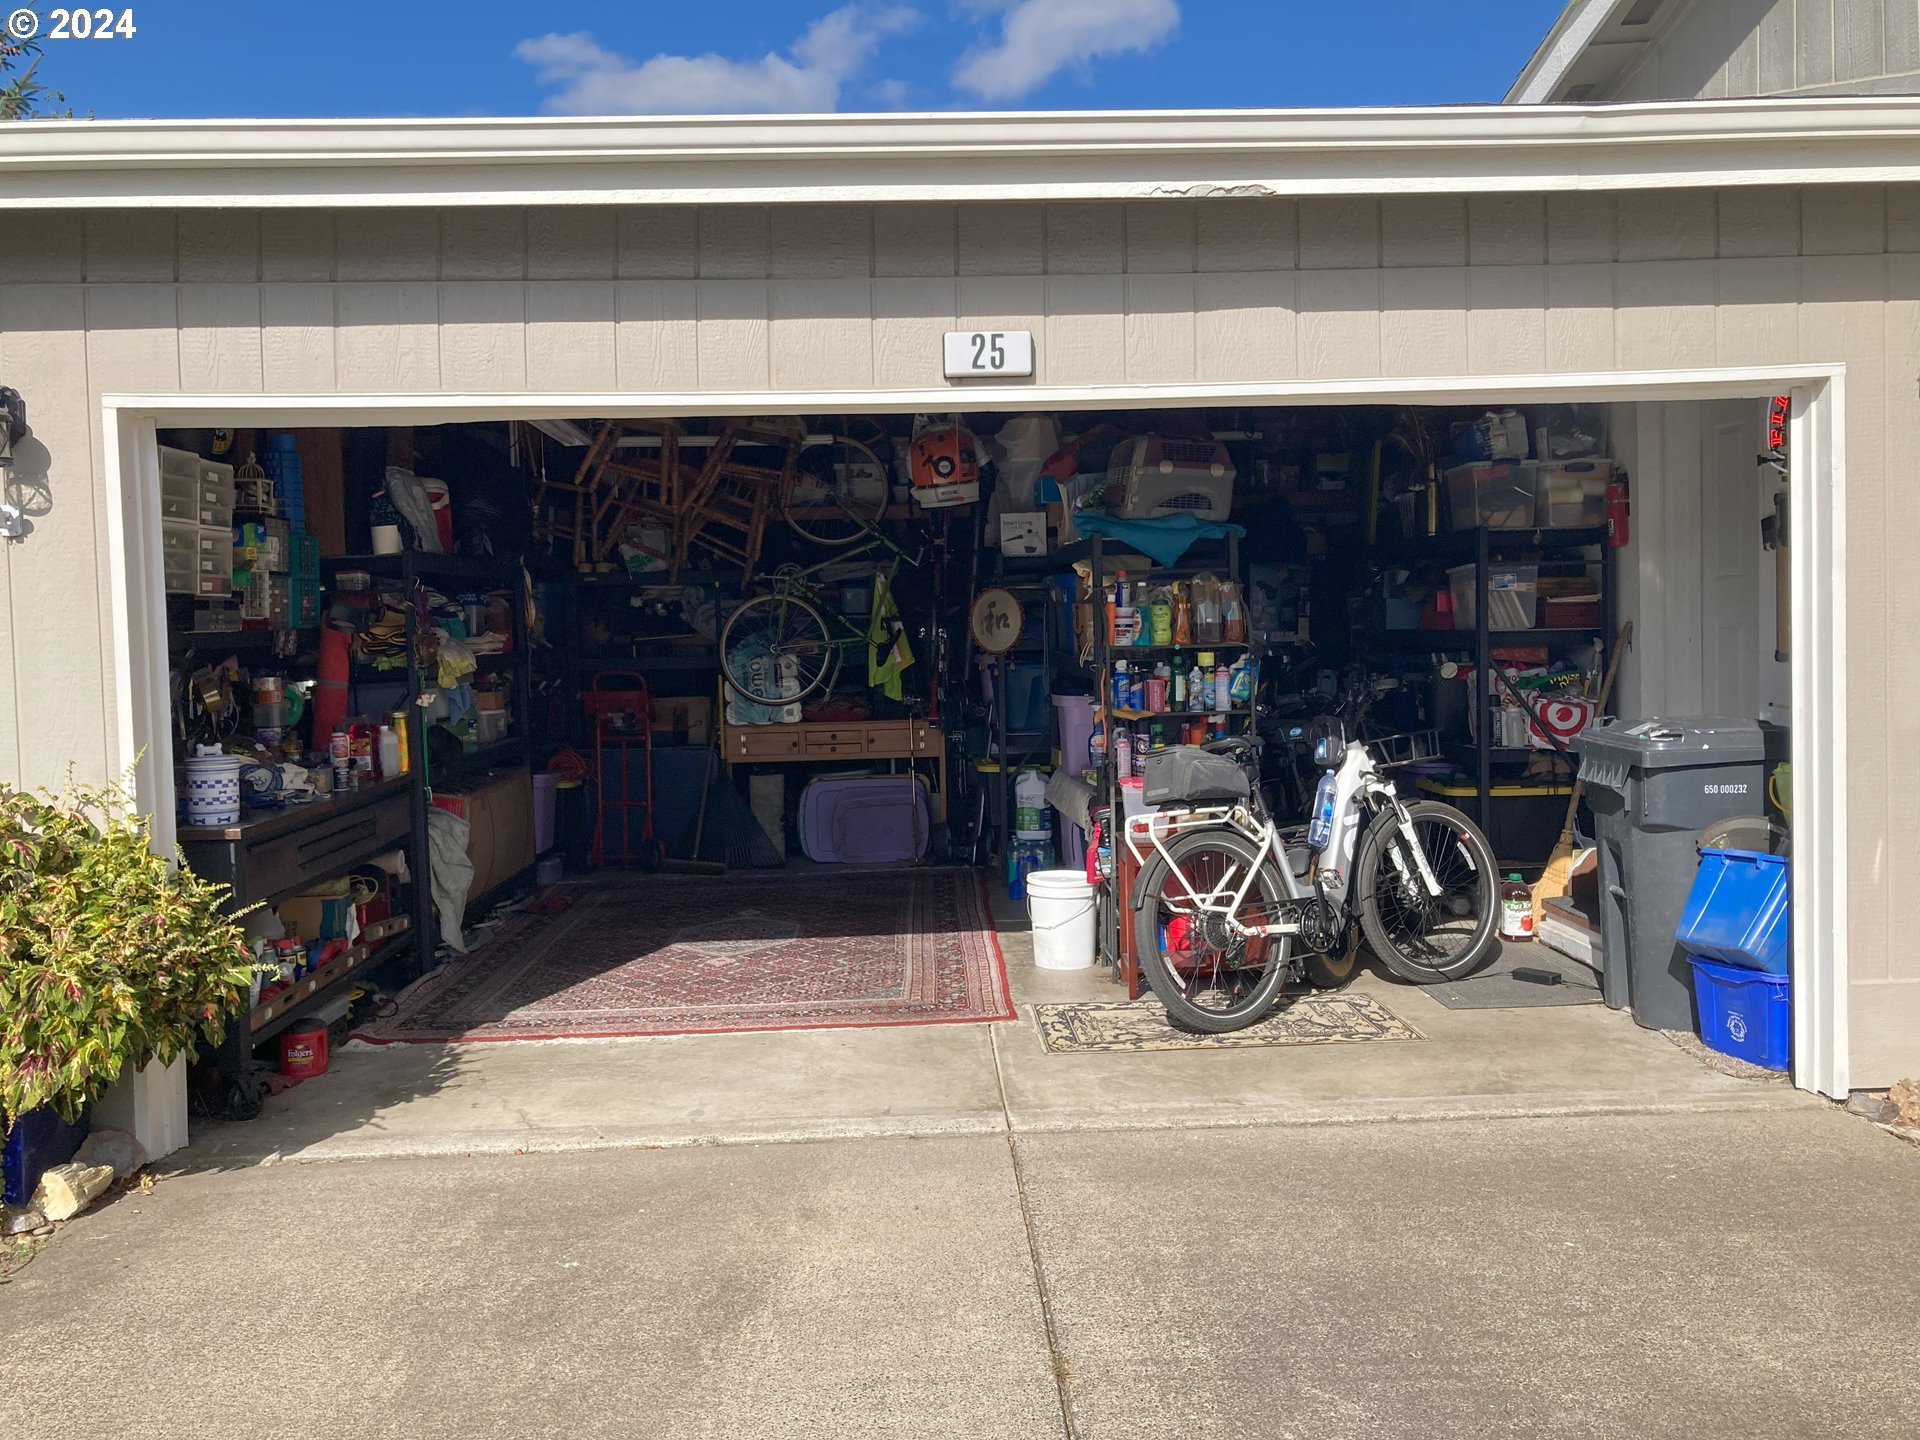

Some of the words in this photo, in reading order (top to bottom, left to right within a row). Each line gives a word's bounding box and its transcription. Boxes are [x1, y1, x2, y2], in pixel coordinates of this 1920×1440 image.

[971, 333, 1005, 370] 25
[1704, 784, 1719, 794] 650
[1720, 784, 1748, 794] 000232
[288, 1049, 314, 1059] Folgers
